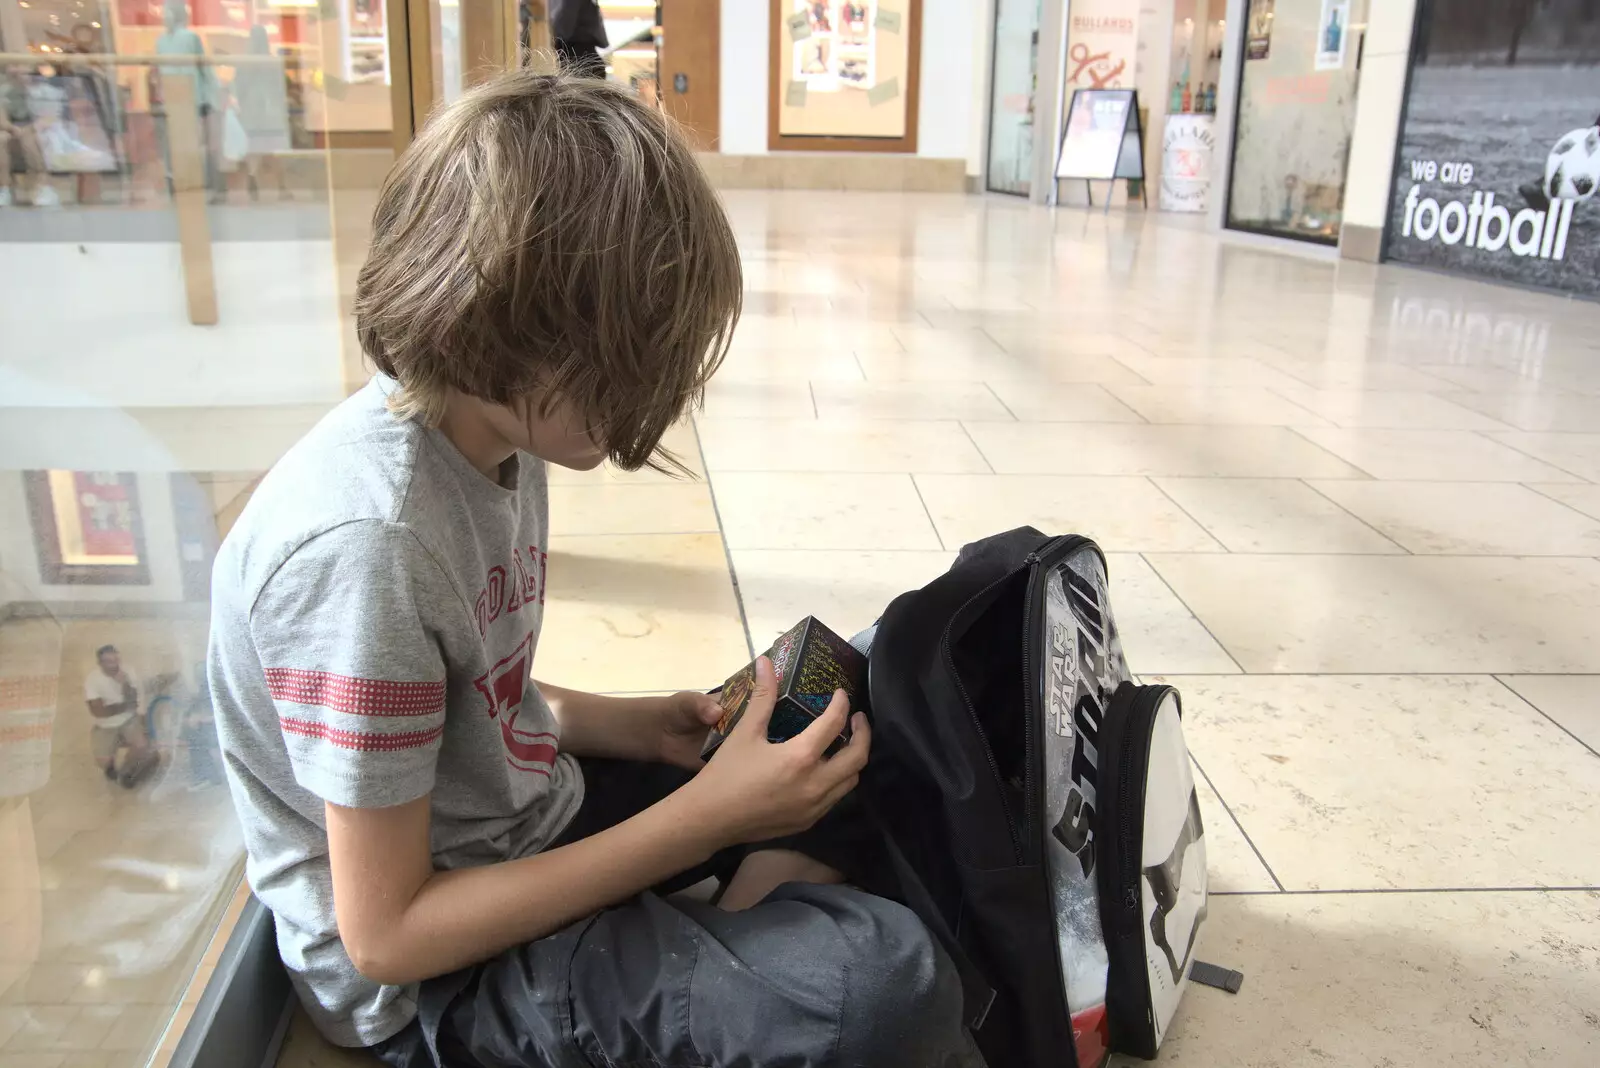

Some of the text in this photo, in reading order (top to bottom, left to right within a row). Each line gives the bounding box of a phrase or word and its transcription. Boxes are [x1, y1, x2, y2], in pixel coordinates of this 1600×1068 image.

[1411, 160, 1474, 185] we are
[1402, 184, 1574, 260] football
[1050, 622, 1067, 736] STAR
[1060, 626, 1077, 739] WARS
